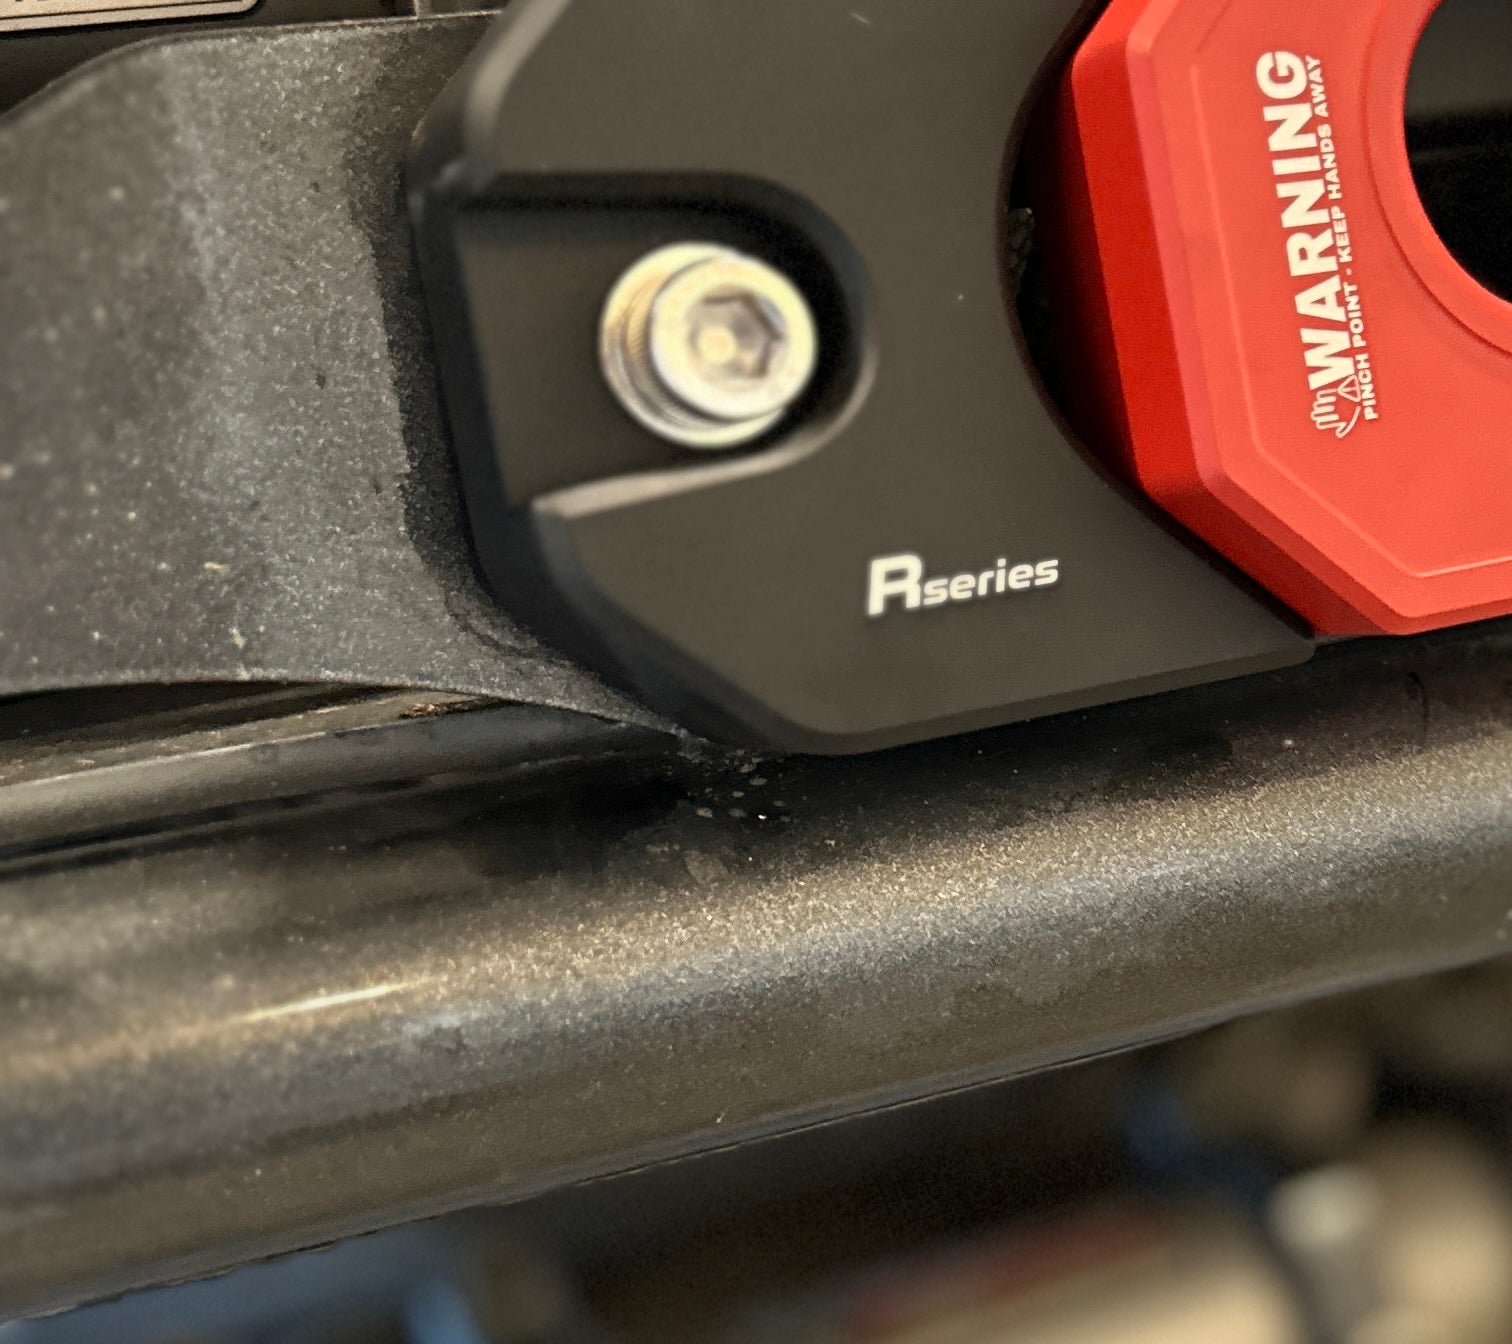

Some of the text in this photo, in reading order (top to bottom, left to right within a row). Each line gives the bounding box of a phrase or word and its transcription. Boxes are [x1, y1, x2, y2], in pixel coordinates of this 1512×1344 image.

[1305, 55, 1329, 118] AWAY
[1317, 123, 1343, 200] HANDS
[1255, 51, 1356, 391] WARNING
[1331, 206, 1353, 264] KEEP
[1343, 281, 1367, 348] POINT
[1355, 353, 1379, 420] PINCH
